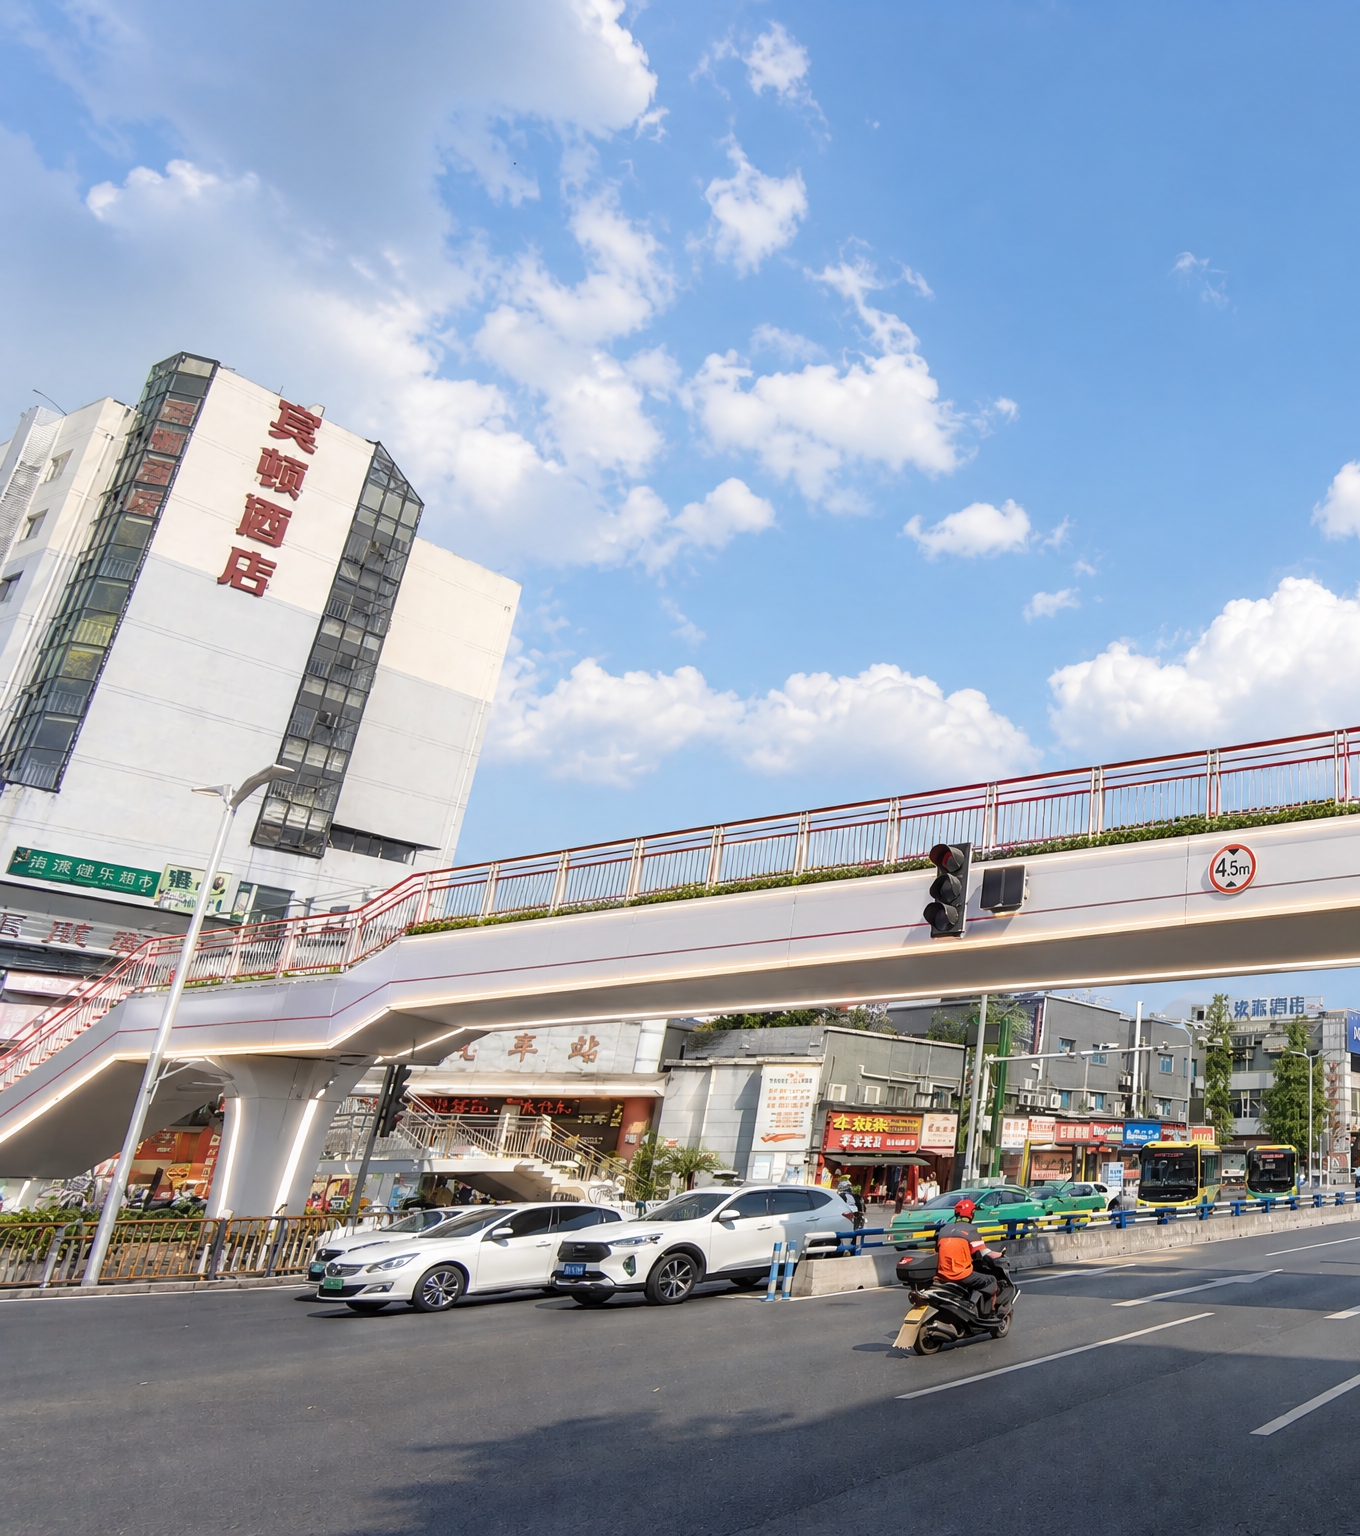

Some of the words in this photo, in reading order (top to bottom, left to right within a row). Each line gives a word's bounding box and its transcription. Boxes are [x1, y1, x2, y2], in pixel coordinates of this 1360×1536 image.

[217, 398, 322, 597] 宾顿酒店
[1214, 857, 1250, 878] 4.5m
[456, 1032, 600, 1064] 车站
